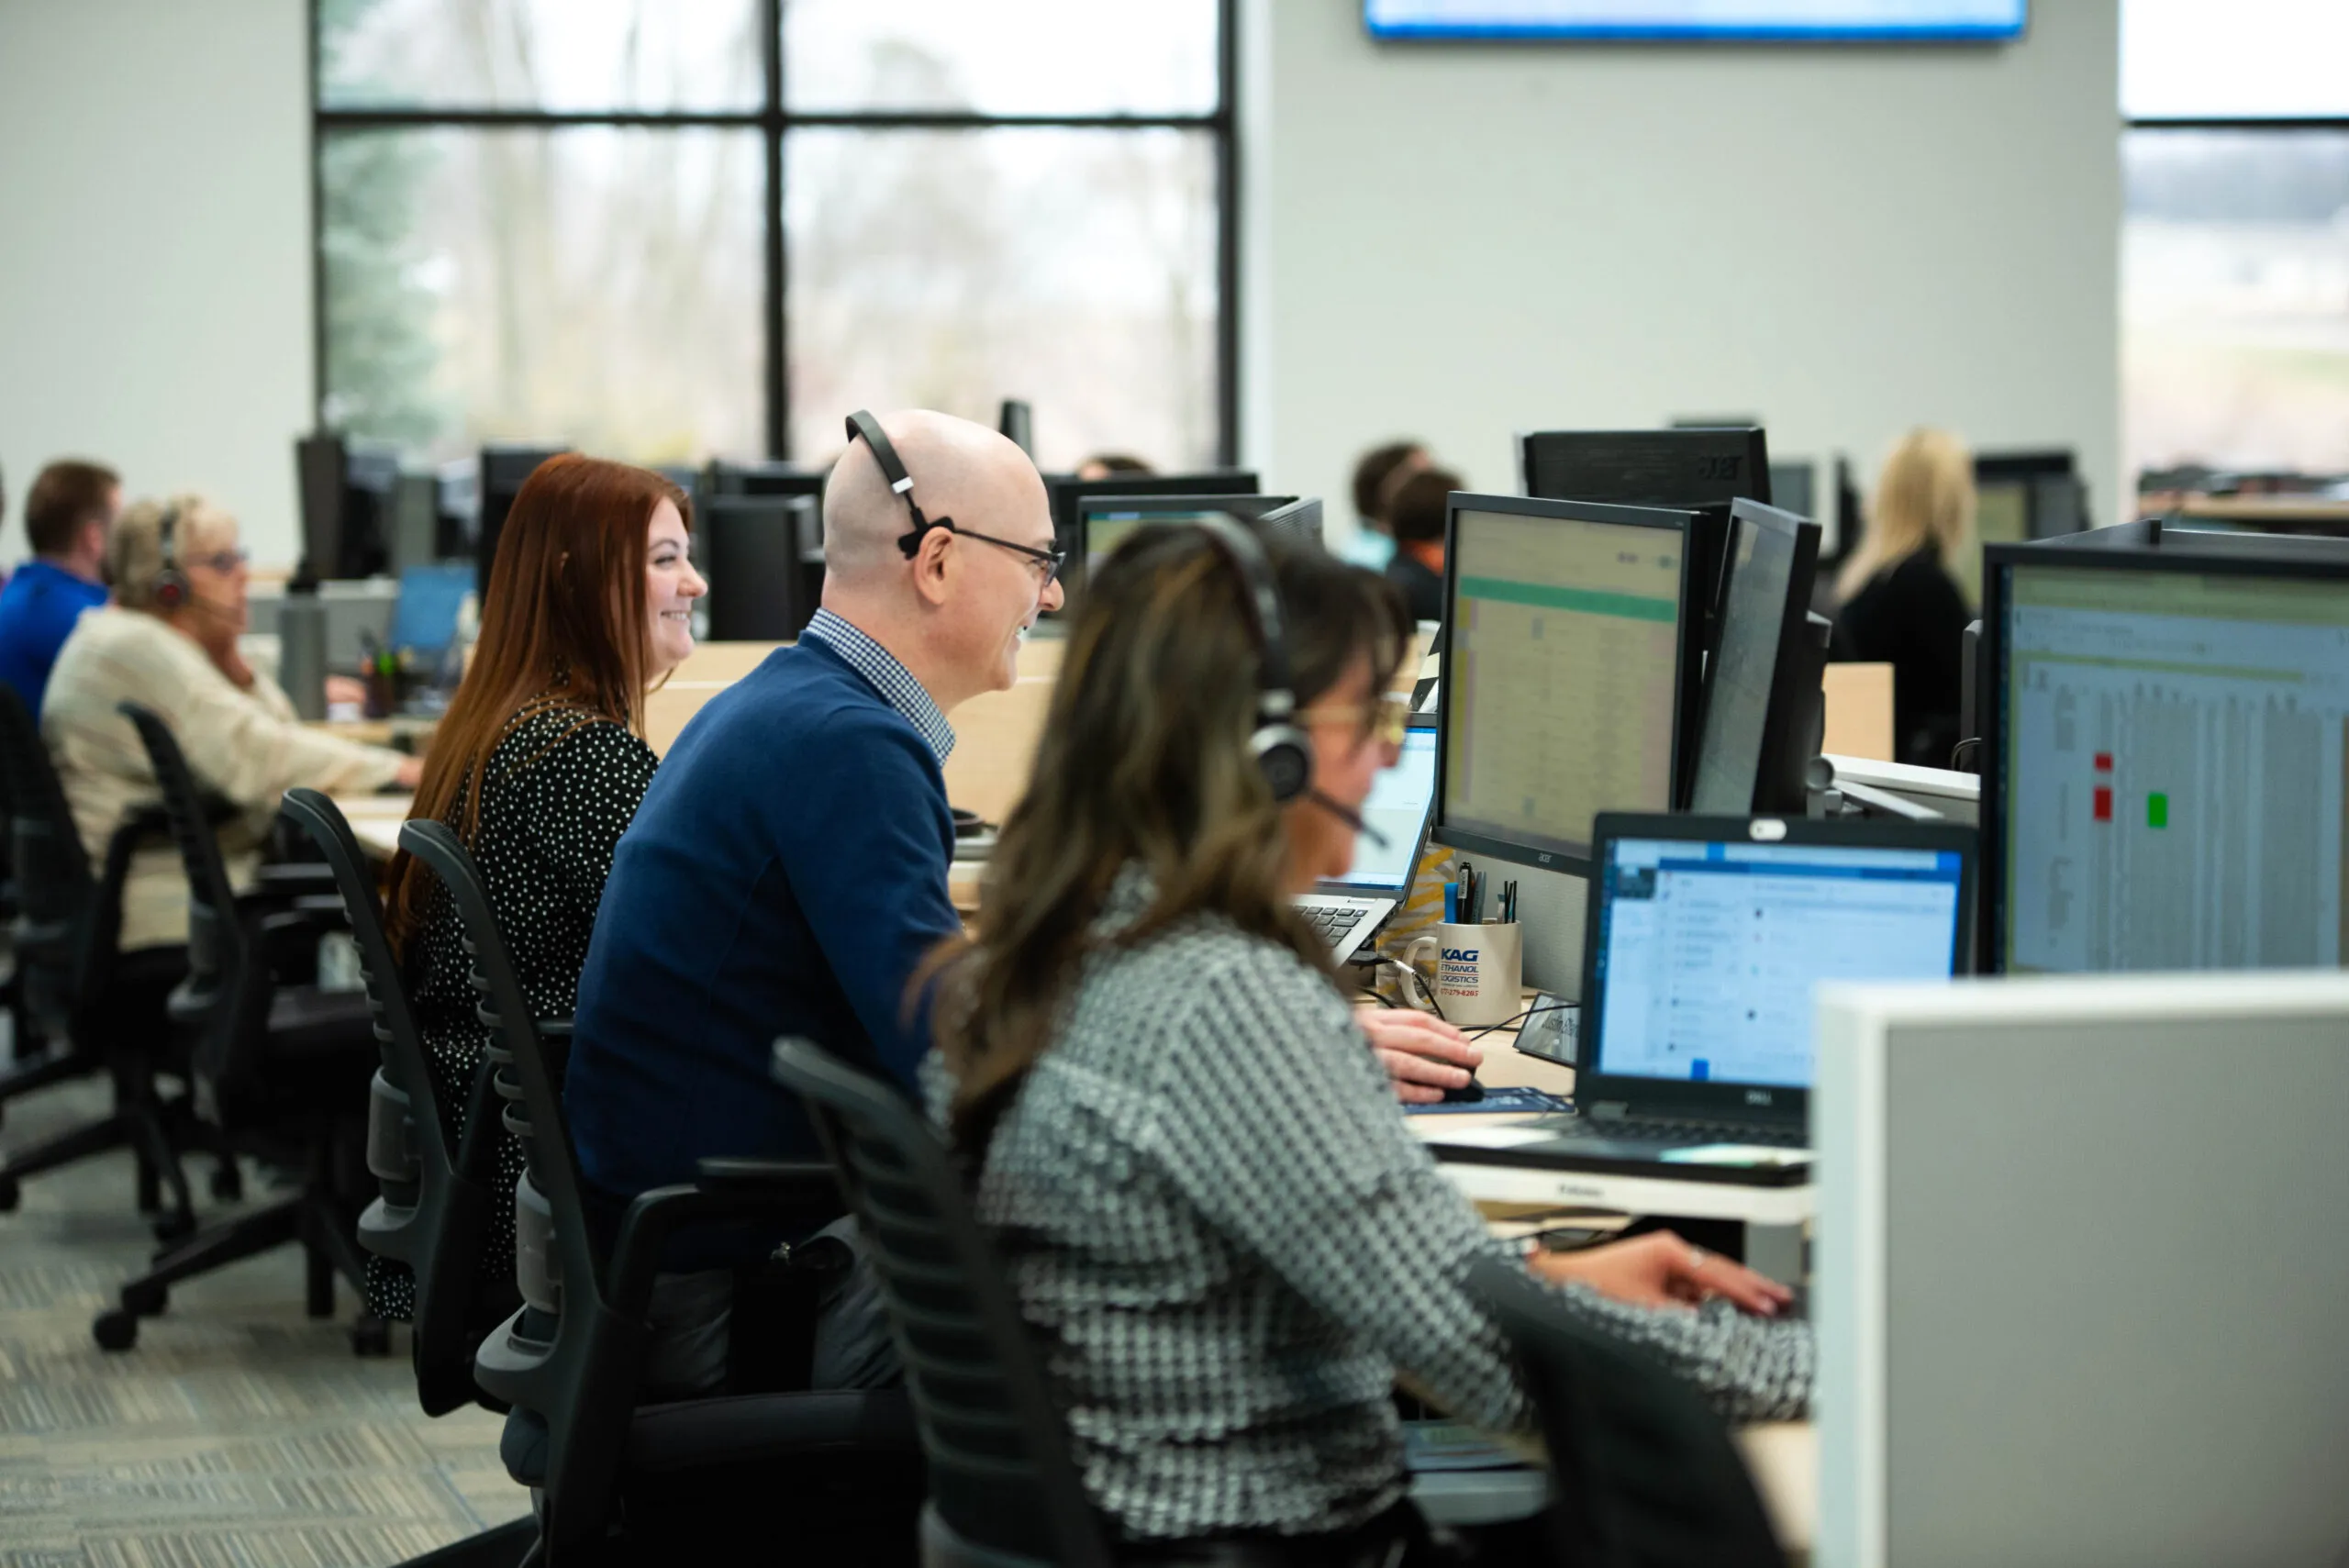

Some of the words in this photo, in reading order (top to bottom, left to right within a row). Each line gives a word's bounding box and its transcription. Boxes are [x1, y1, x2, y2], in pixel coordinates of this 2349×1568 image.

[1441, 948, 1479, 962] KAG
[1441, 963, 1479, 973] ETHANOL
[1441, 974, 1479, 984] LOGISTICS
